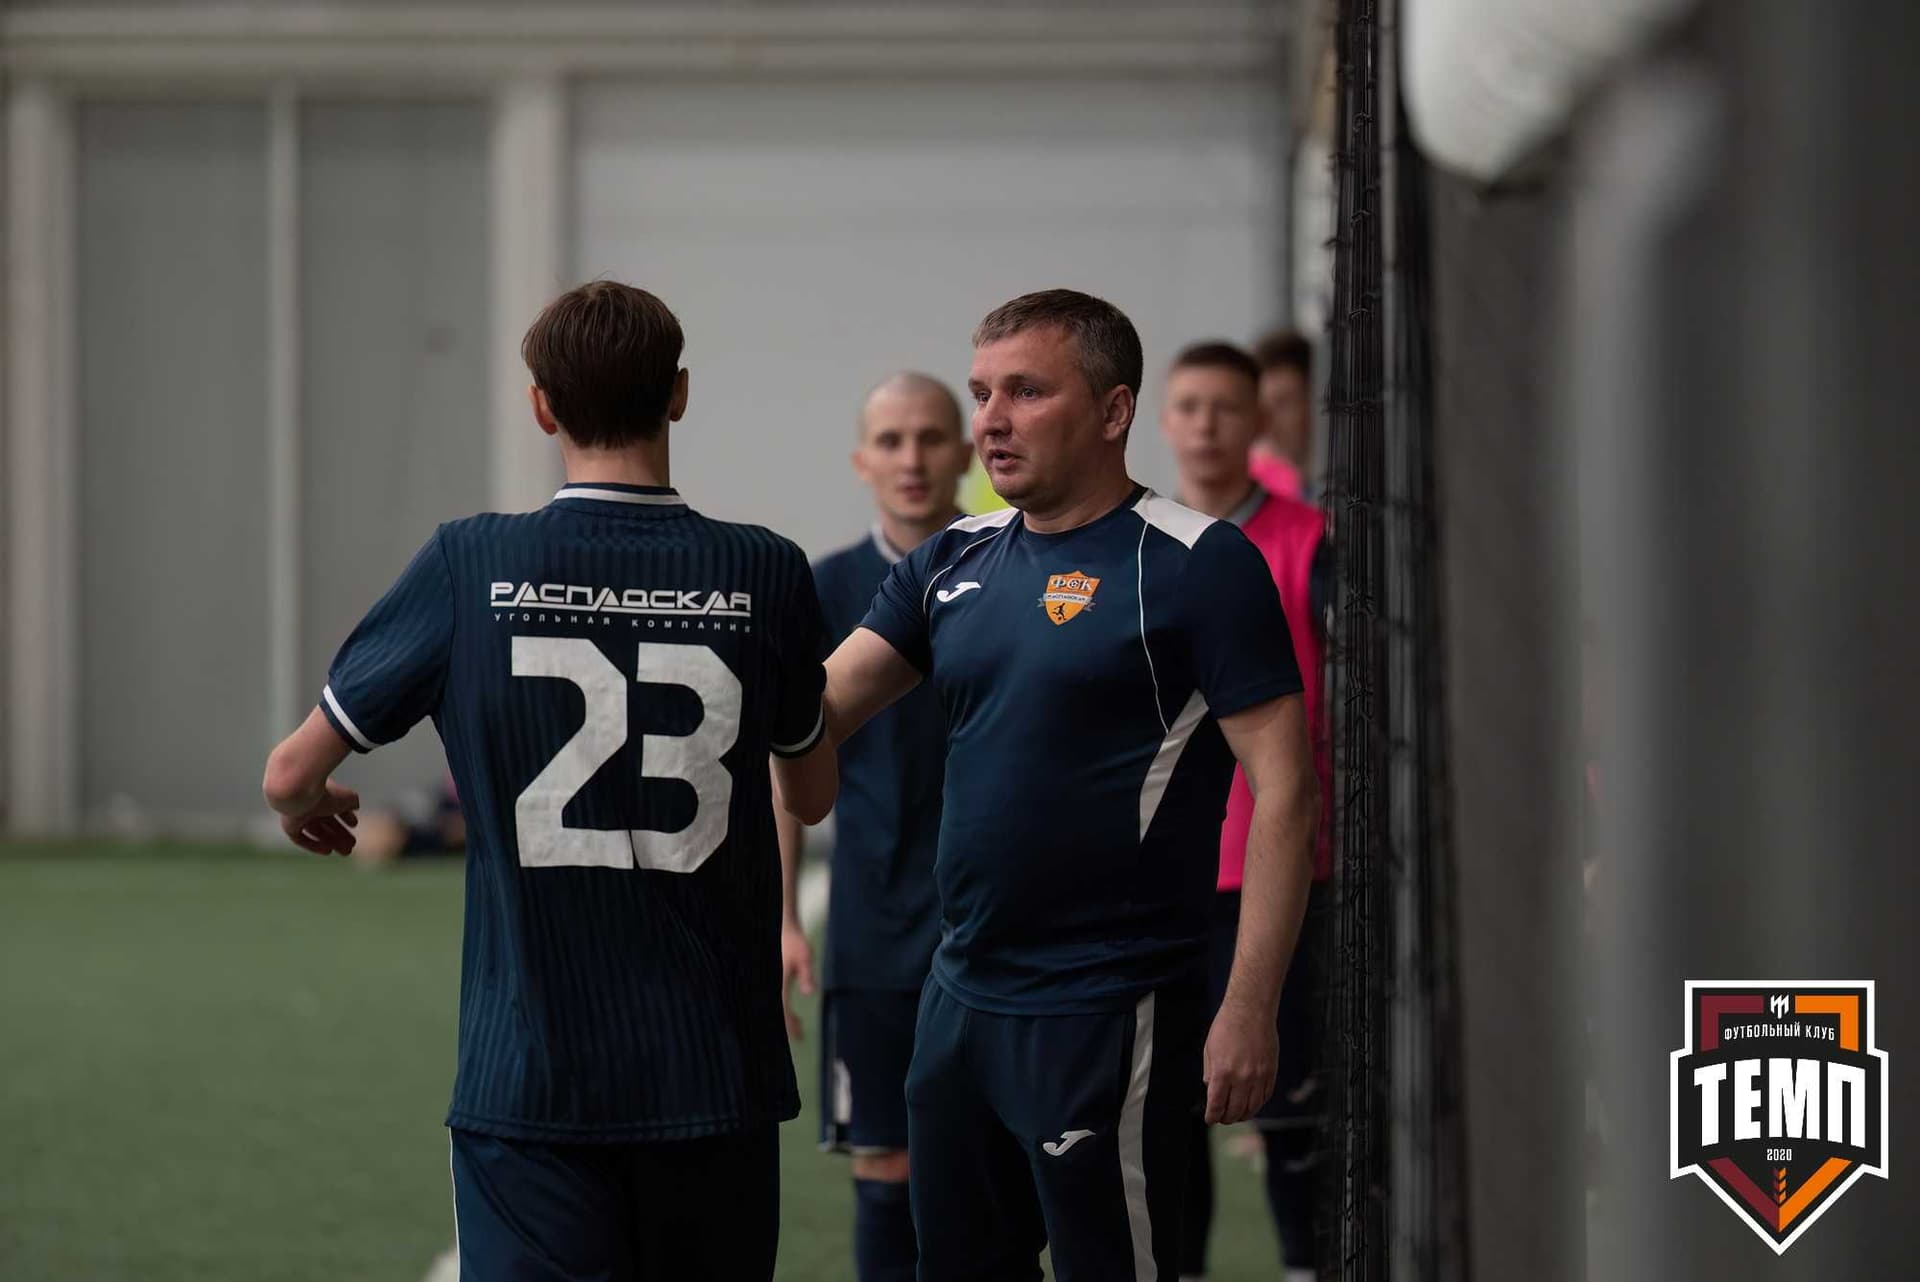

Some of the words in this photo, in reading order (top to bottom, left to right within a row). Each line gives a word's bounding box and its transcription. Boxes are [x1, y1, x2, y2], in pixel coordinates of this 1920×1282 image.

[490, 581, 751, 617] РАСПАДСКАЯ
[494, 612, 610, 625] УГОЛЬНАЯ
[511, 635, 743, 874] 23
